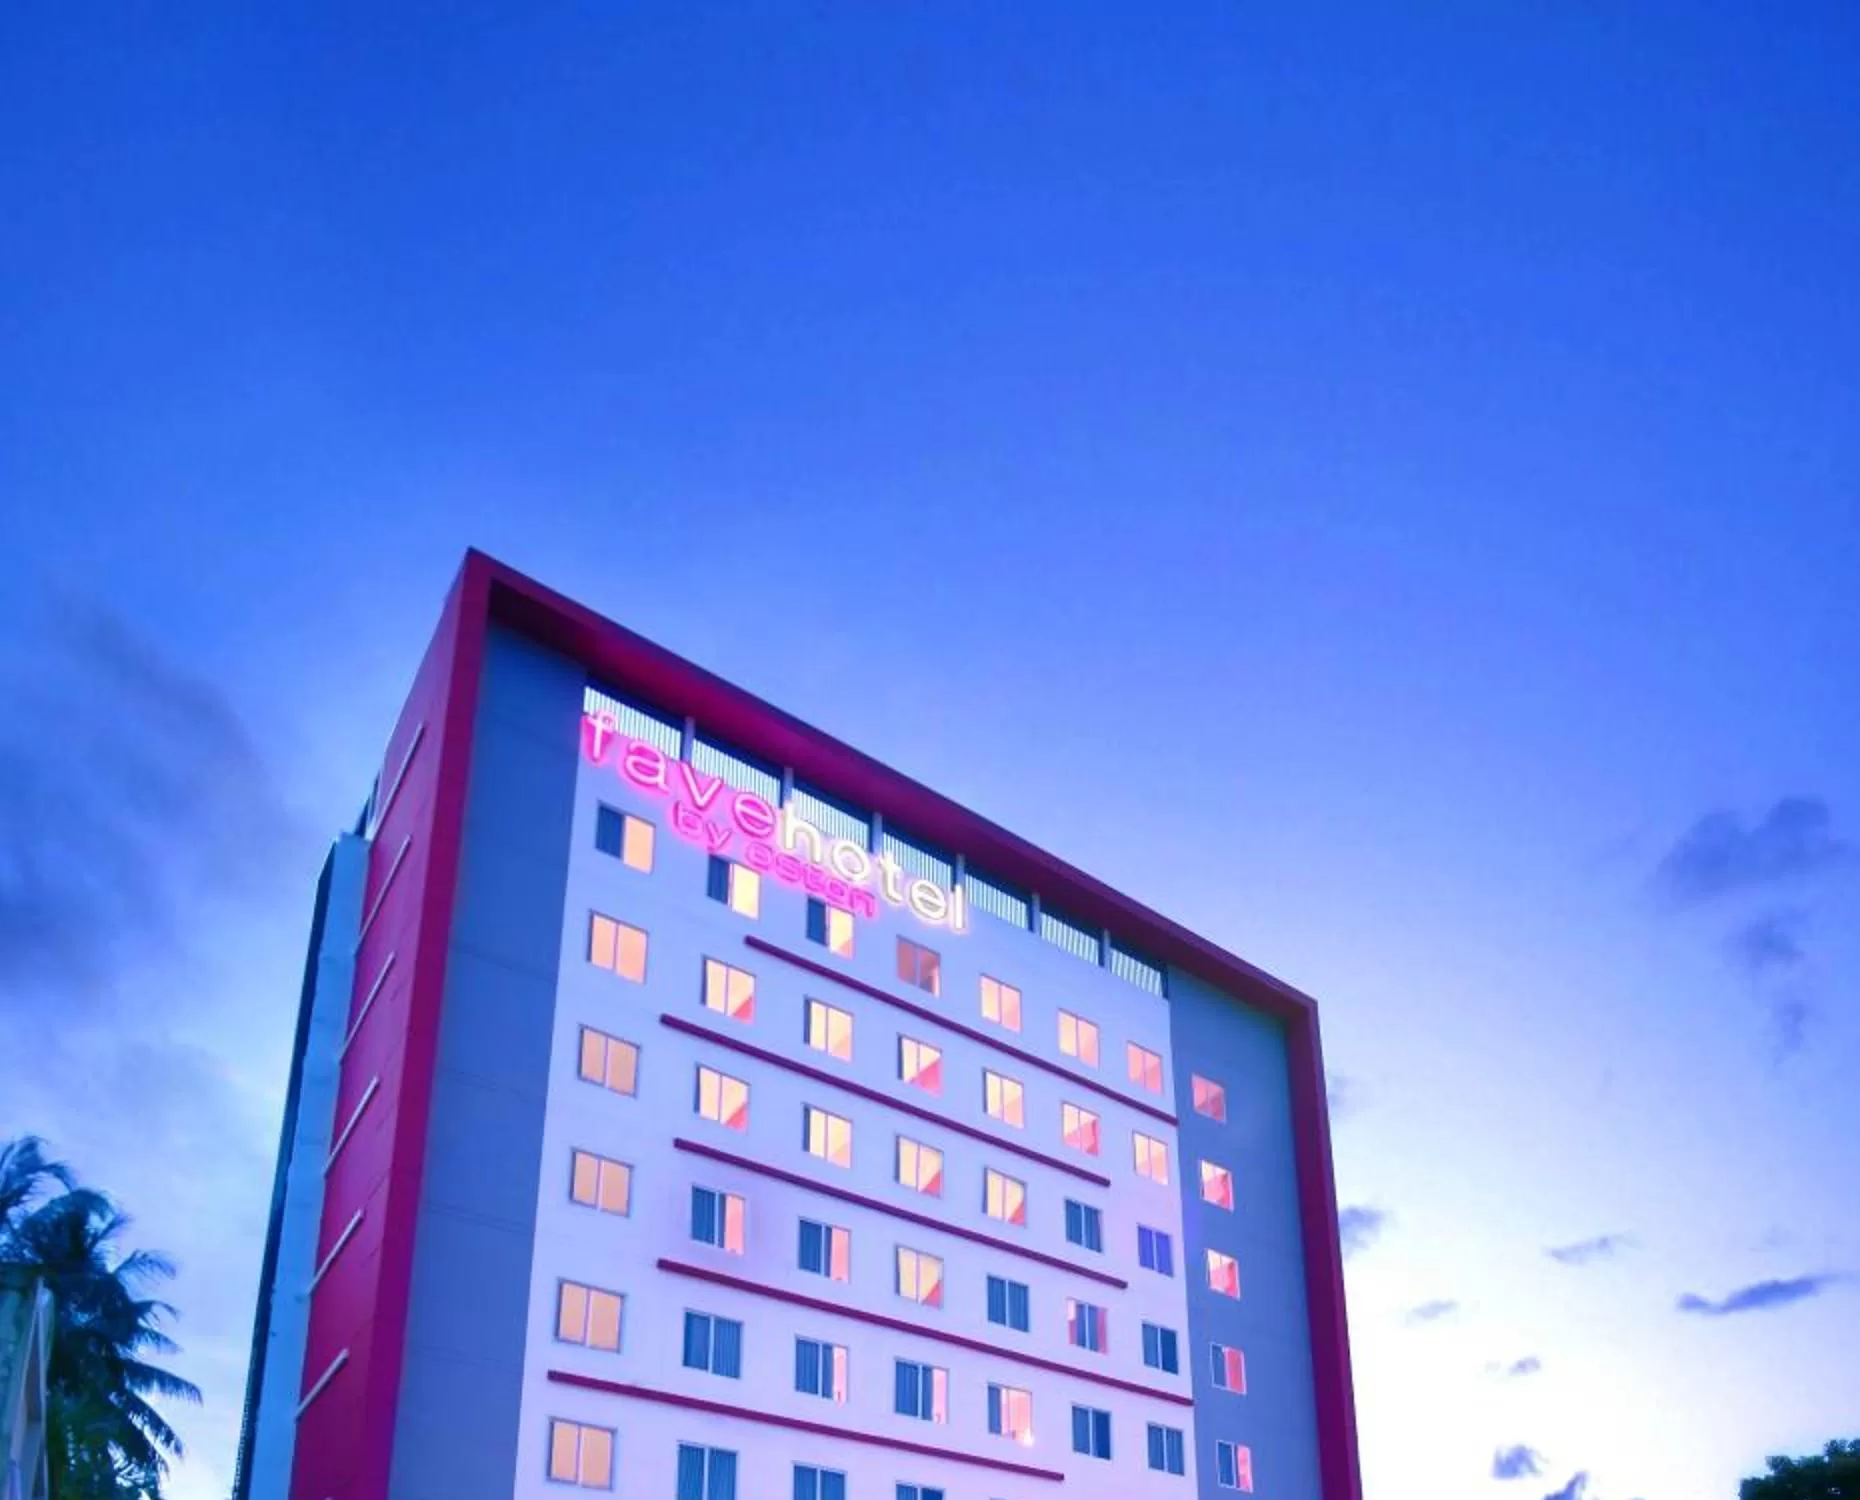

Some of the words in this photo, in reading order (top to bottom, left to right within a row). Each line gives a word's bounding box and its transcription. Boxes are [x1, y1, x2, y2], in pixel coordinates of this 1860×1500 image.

[581, 710, 967, 931] favehotel
[672, 800, 732, 853] by
[744, 841, 878, 919] aston
